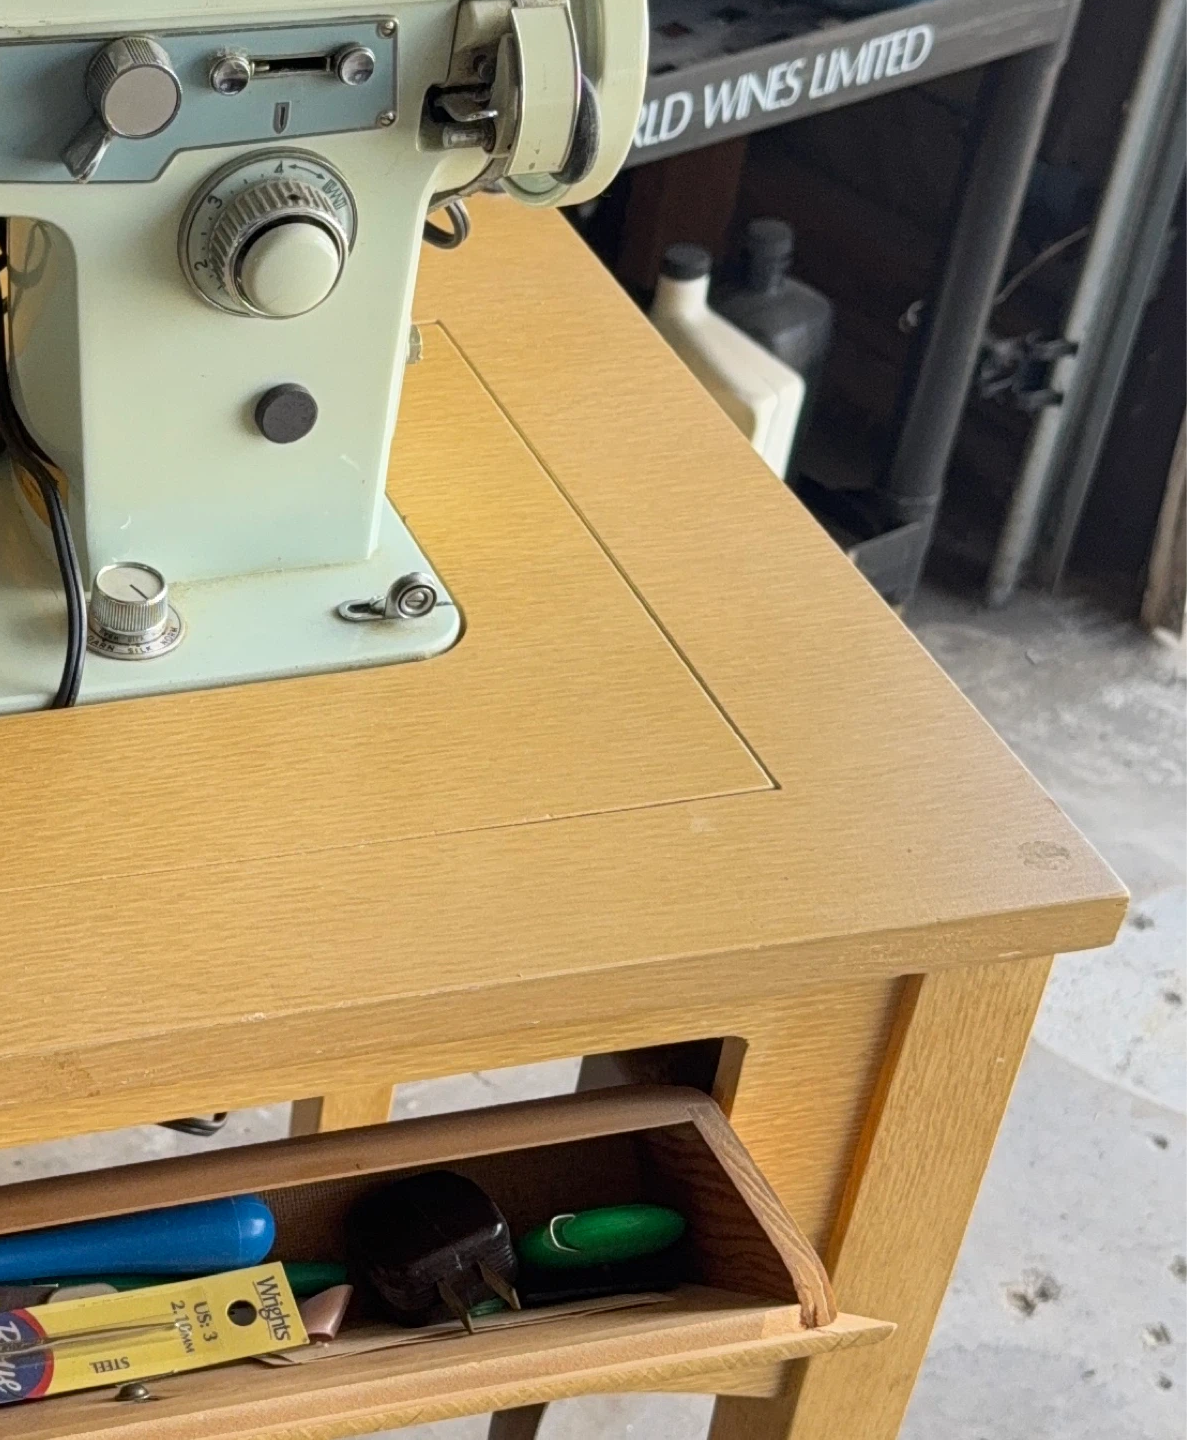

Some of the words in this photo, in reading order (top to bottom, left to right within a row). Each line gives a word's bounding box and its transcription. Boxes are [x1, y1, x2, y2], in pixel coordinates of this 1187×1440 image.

[633, 90, 694, 149] RLD
[704, 57, 806, 130] WINES
[808, 22, 936, 100] LIMITED
[193, 1300, 210, 1329] US:
[202, 1330, 219, 1343] 3
[255, 1275, 292, 1342] Wrights
[89, 1356, 131, 1374] STEEL
